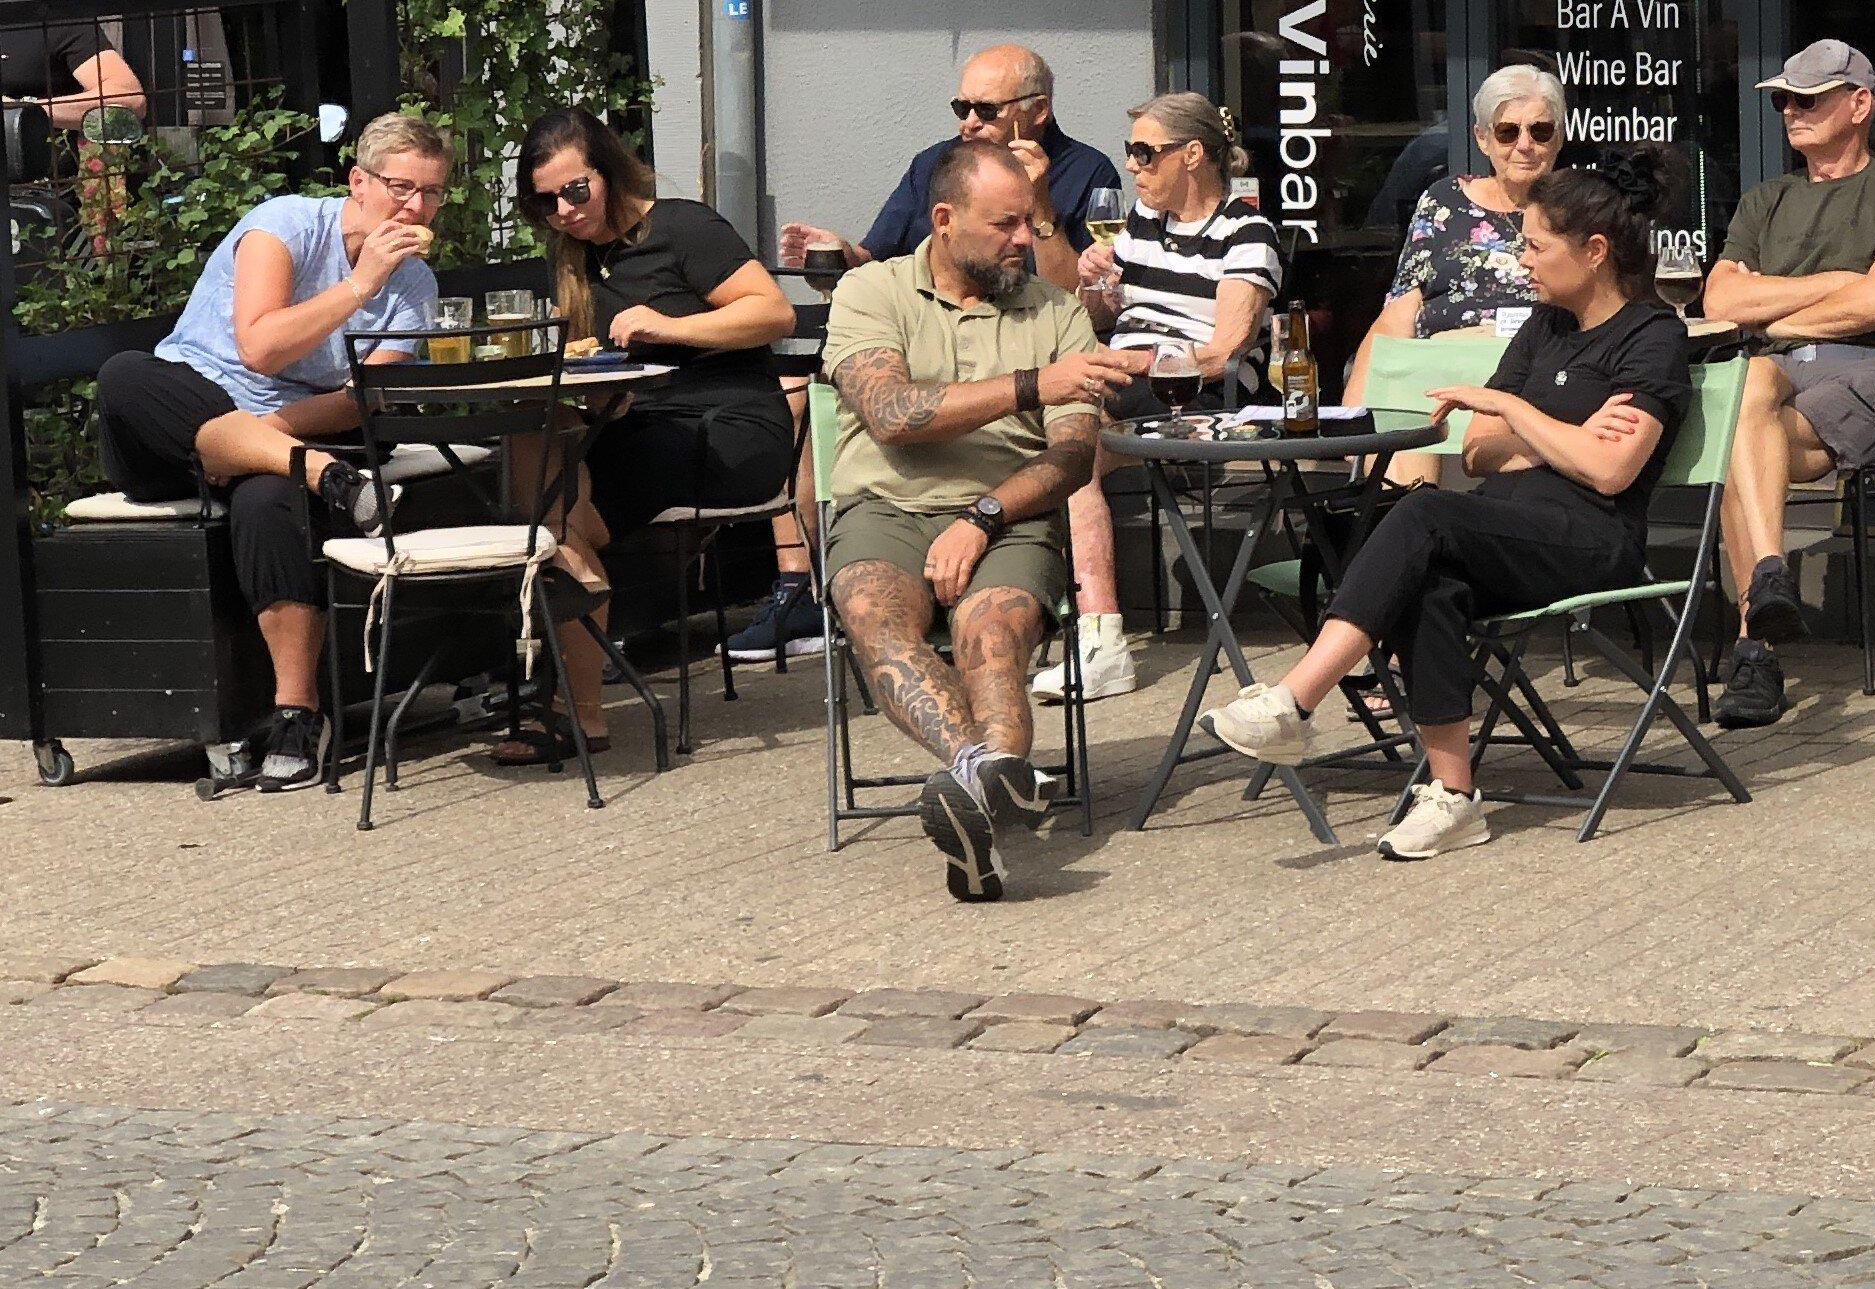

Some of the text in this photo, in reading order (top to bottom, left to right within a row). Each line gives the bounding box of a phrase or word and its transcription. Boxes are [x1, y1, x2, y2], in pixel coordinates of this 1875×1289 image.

[1555, 51, 1682, 87] Wine Bar
[1563, 106, 1677, 144] Weinbar
[1650, 220, 1708, 260] inos
